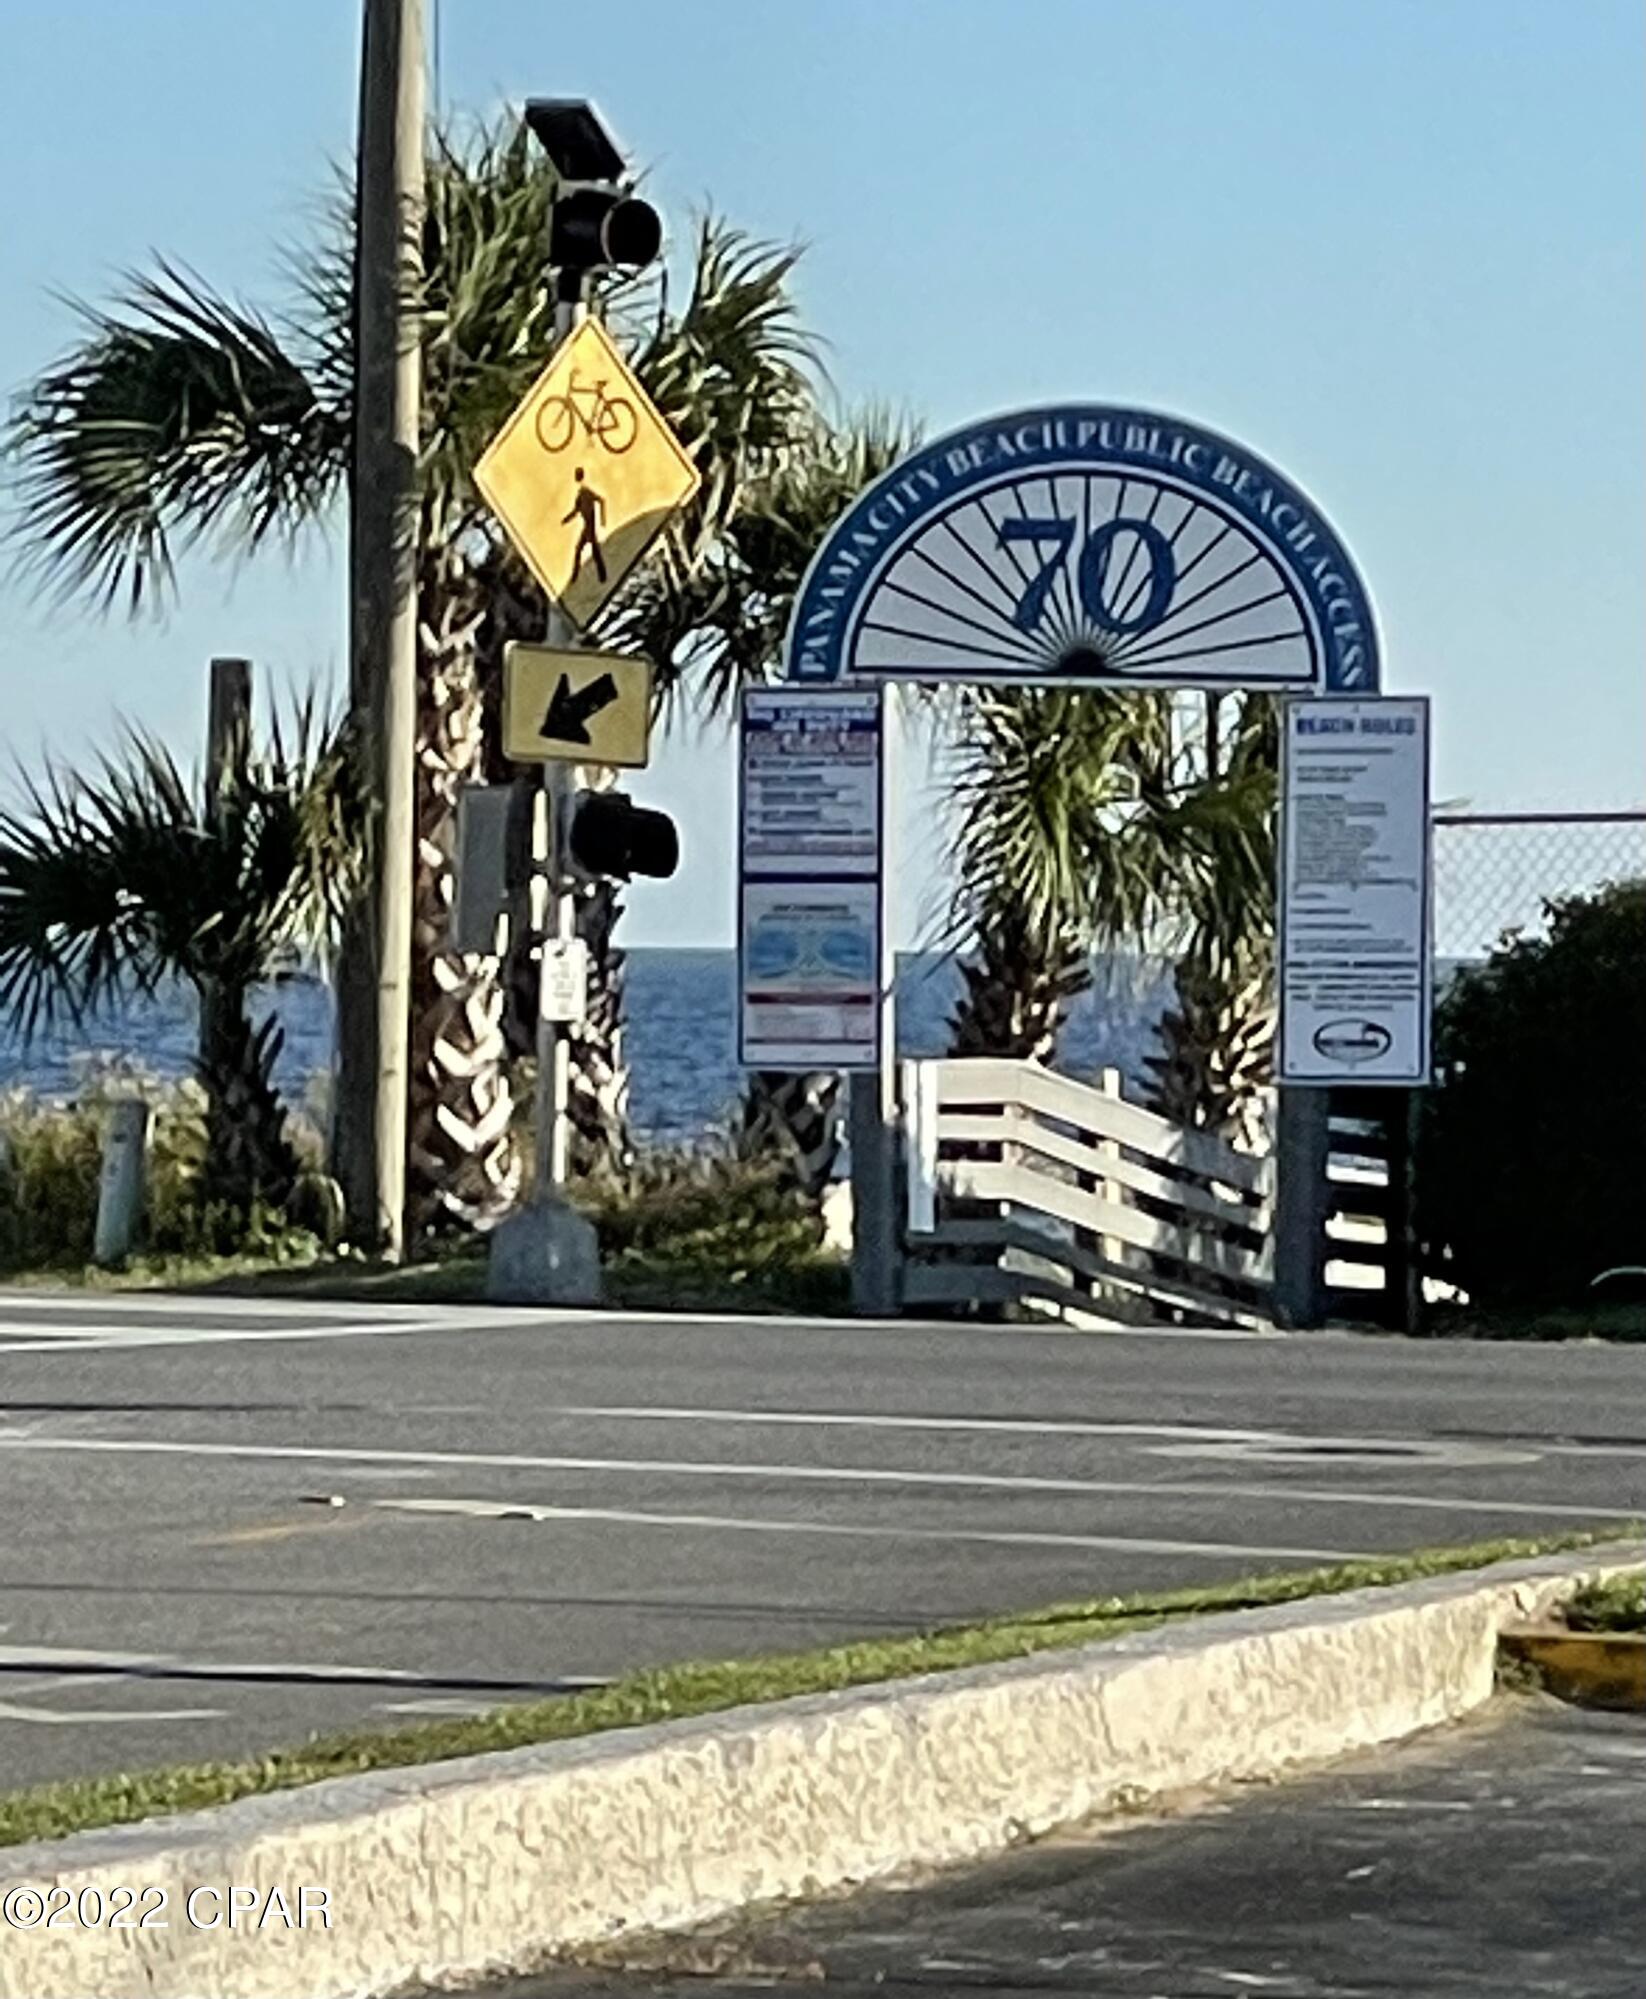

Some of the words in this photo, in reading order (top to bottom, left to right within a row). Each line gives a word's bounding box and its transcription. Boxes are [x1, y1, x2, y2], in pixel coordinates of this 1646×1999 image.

[800, 530, 878, 673] PANAMA
[867, 457, 946, 531] CITY
[945, 420, 1067, 477] BEACH
[1076, 420, 1210, 472] PUBLIC
[1211, 455, 1317, 552] BEACH
[1303, 554, 1368, 687] ACCESS
[995, 514, 1175, 633] 70
